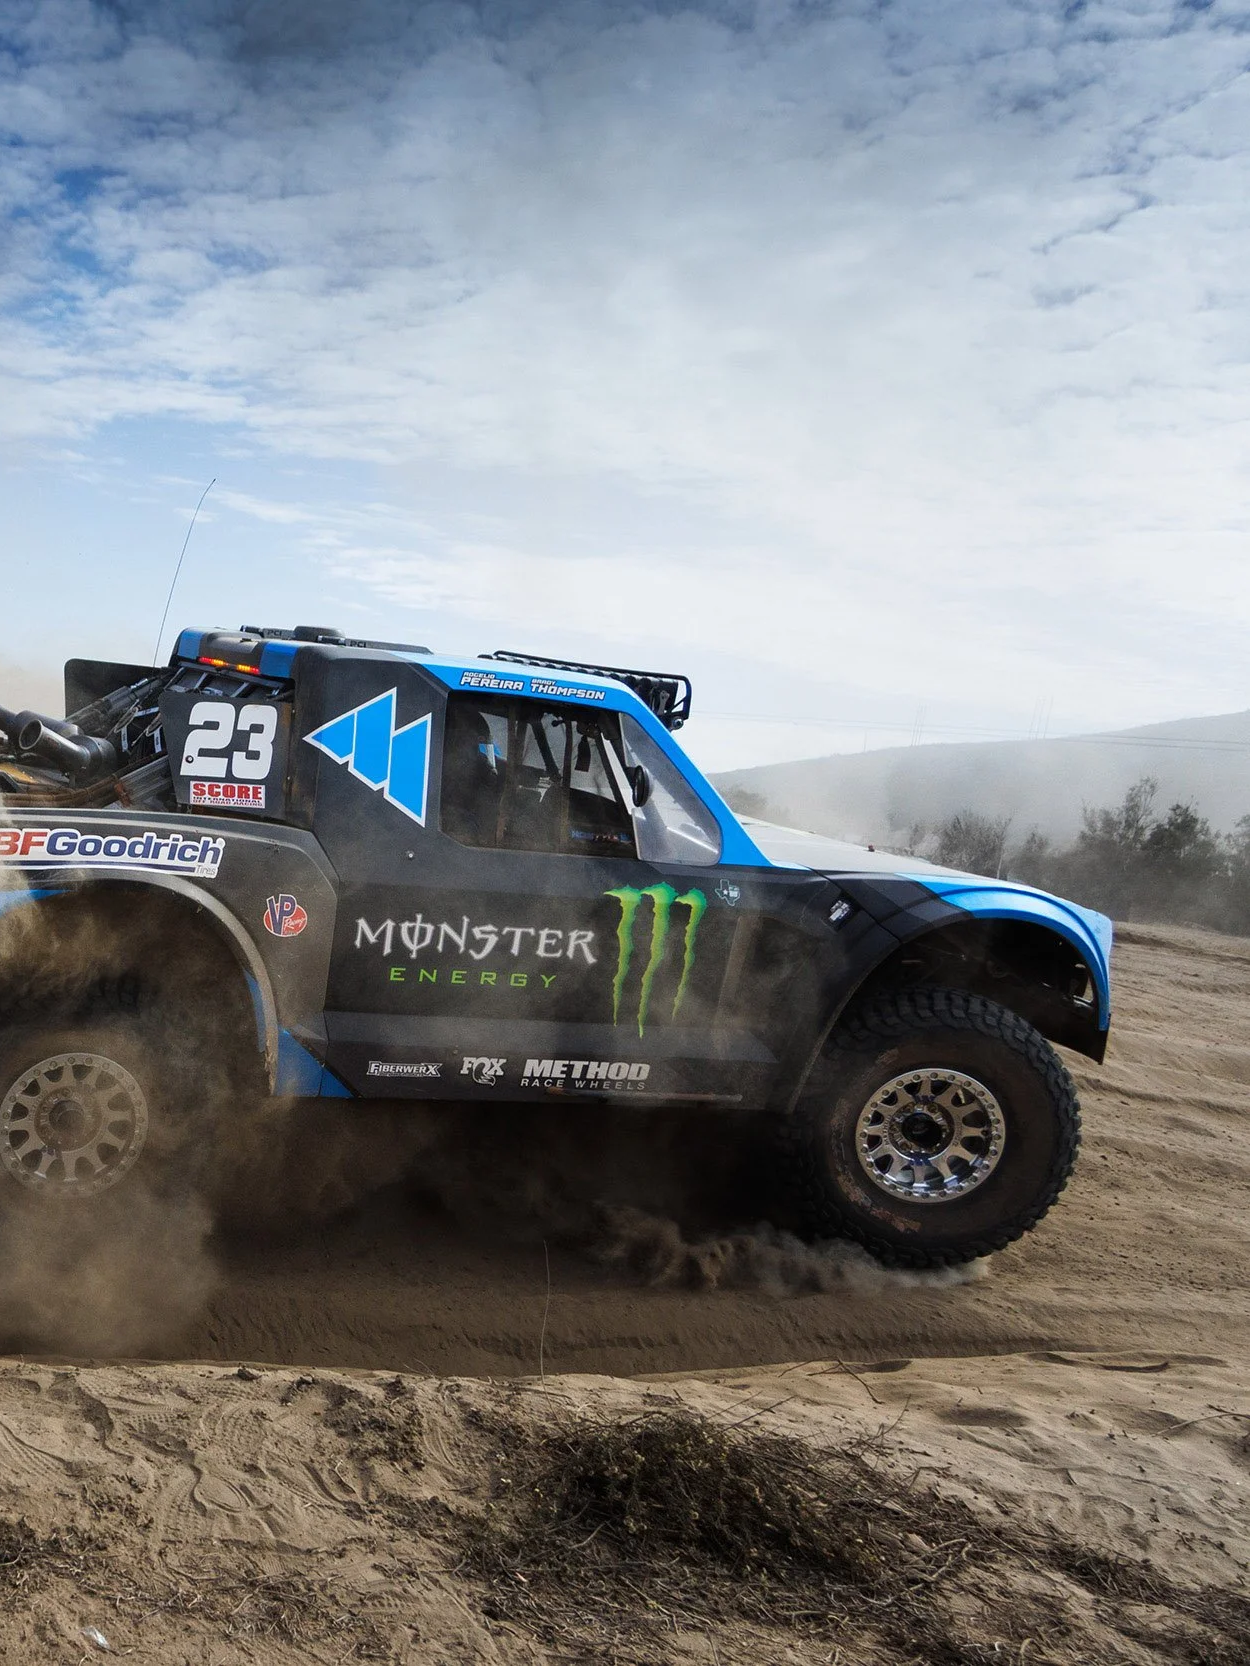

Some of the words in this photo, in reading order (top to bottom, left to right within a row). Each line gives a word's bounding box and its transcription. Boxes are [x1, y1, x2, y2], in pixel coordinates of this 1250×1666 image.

[460, 677, 524, 690] PEREIRA
[463, 671, 496, 679] ROGELIO
[531, 678, 556, 686] BRADY
[530, 683, 605, 700] THOMPSON
[180, 701, 278, 780] 23
[193, 783, 263, 800] SCORE
[266, 894, 297, 936] VP
[354, 913, 597, 965] MONSTER
[390, 967, 557, 988] ENERGY
[460, 1056, 507, 1083] FOX
[523, 1059, 650, 1081] METHOD
[520, 1078, 564, 1087] RACE
[575, 1080, 646, 1090] WHEELS
